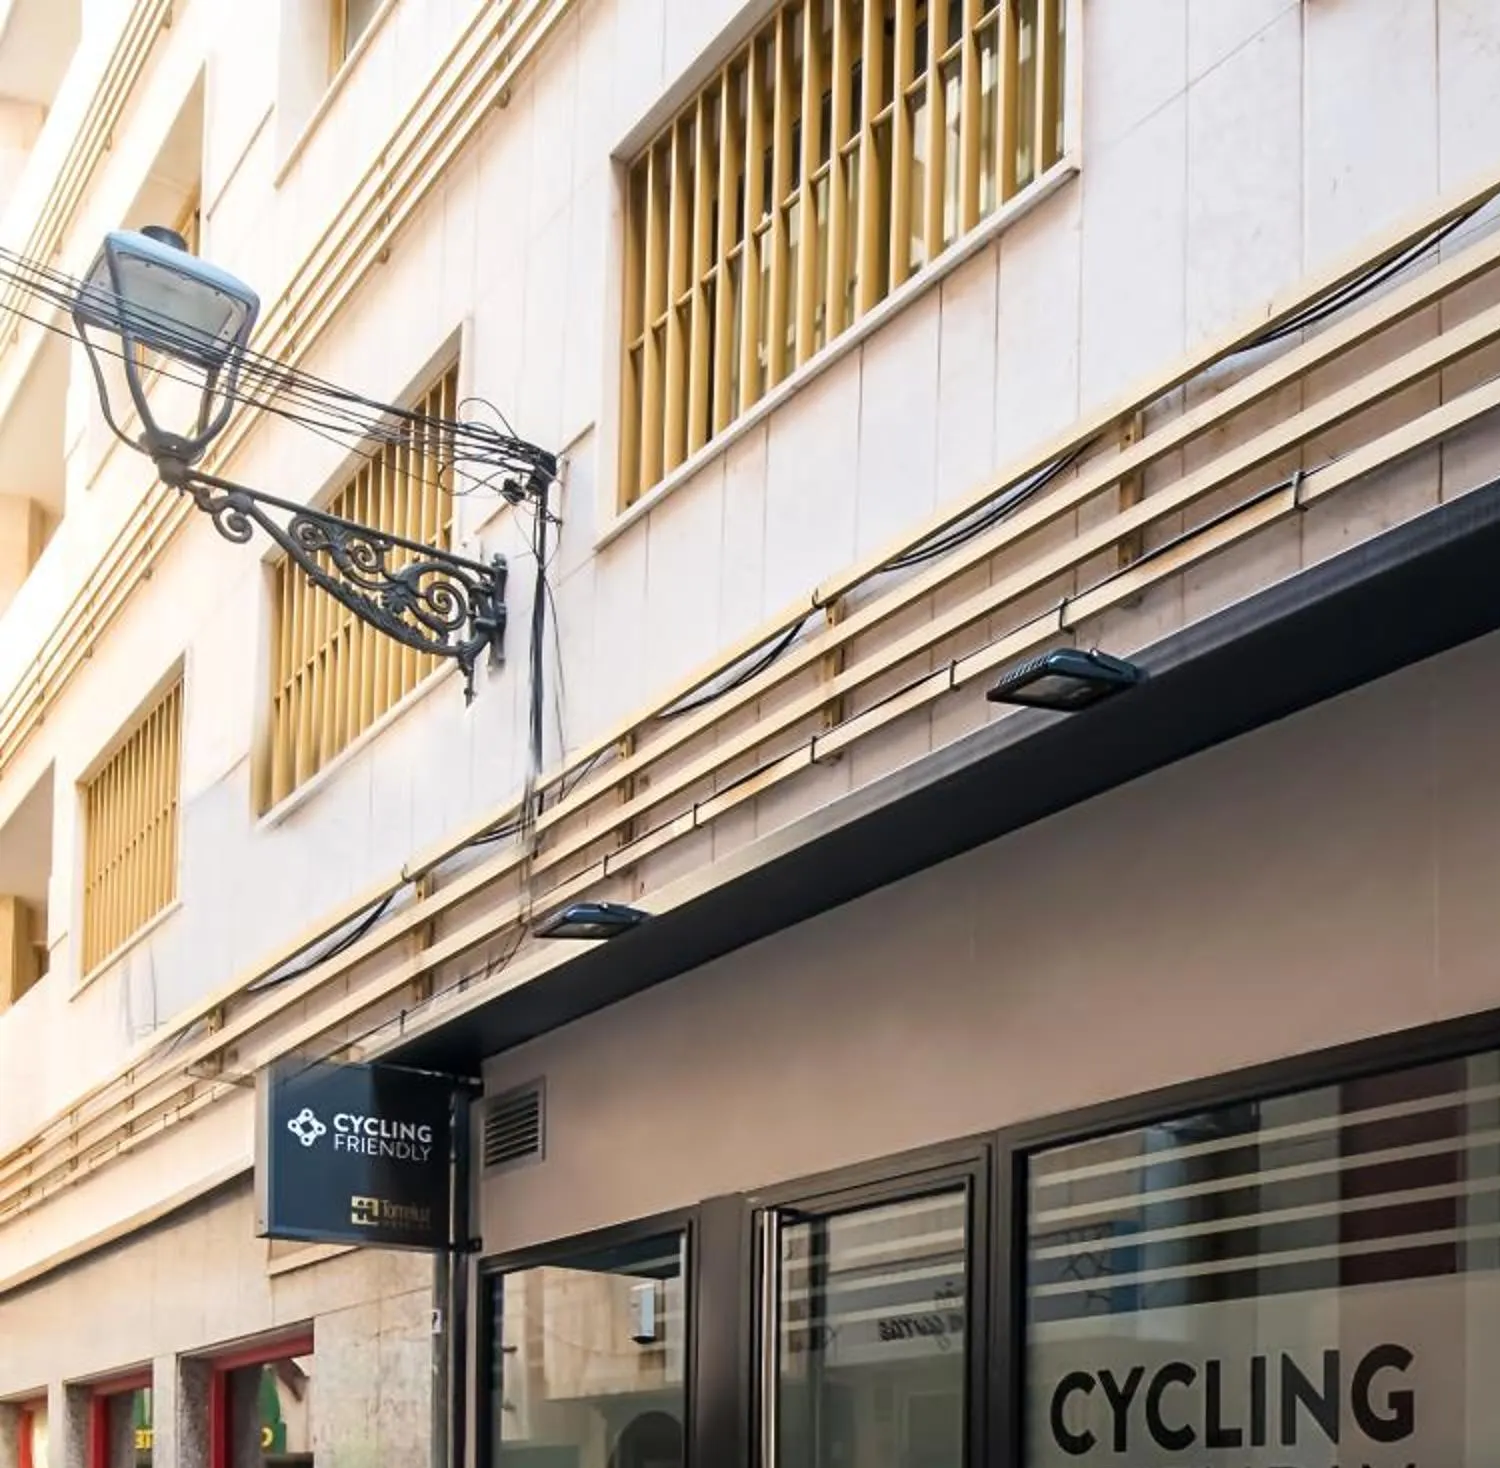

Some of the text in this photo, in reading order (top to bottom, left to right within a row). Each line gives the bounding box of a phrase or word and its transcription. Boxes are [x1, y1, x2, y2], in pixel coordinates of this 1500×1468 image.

[333, 1113, 433, 1143] CYCLING
[334, 1133, 432, 1161] FRIENDLY
[1050, 1343, 1415, 1455] CYCLING
